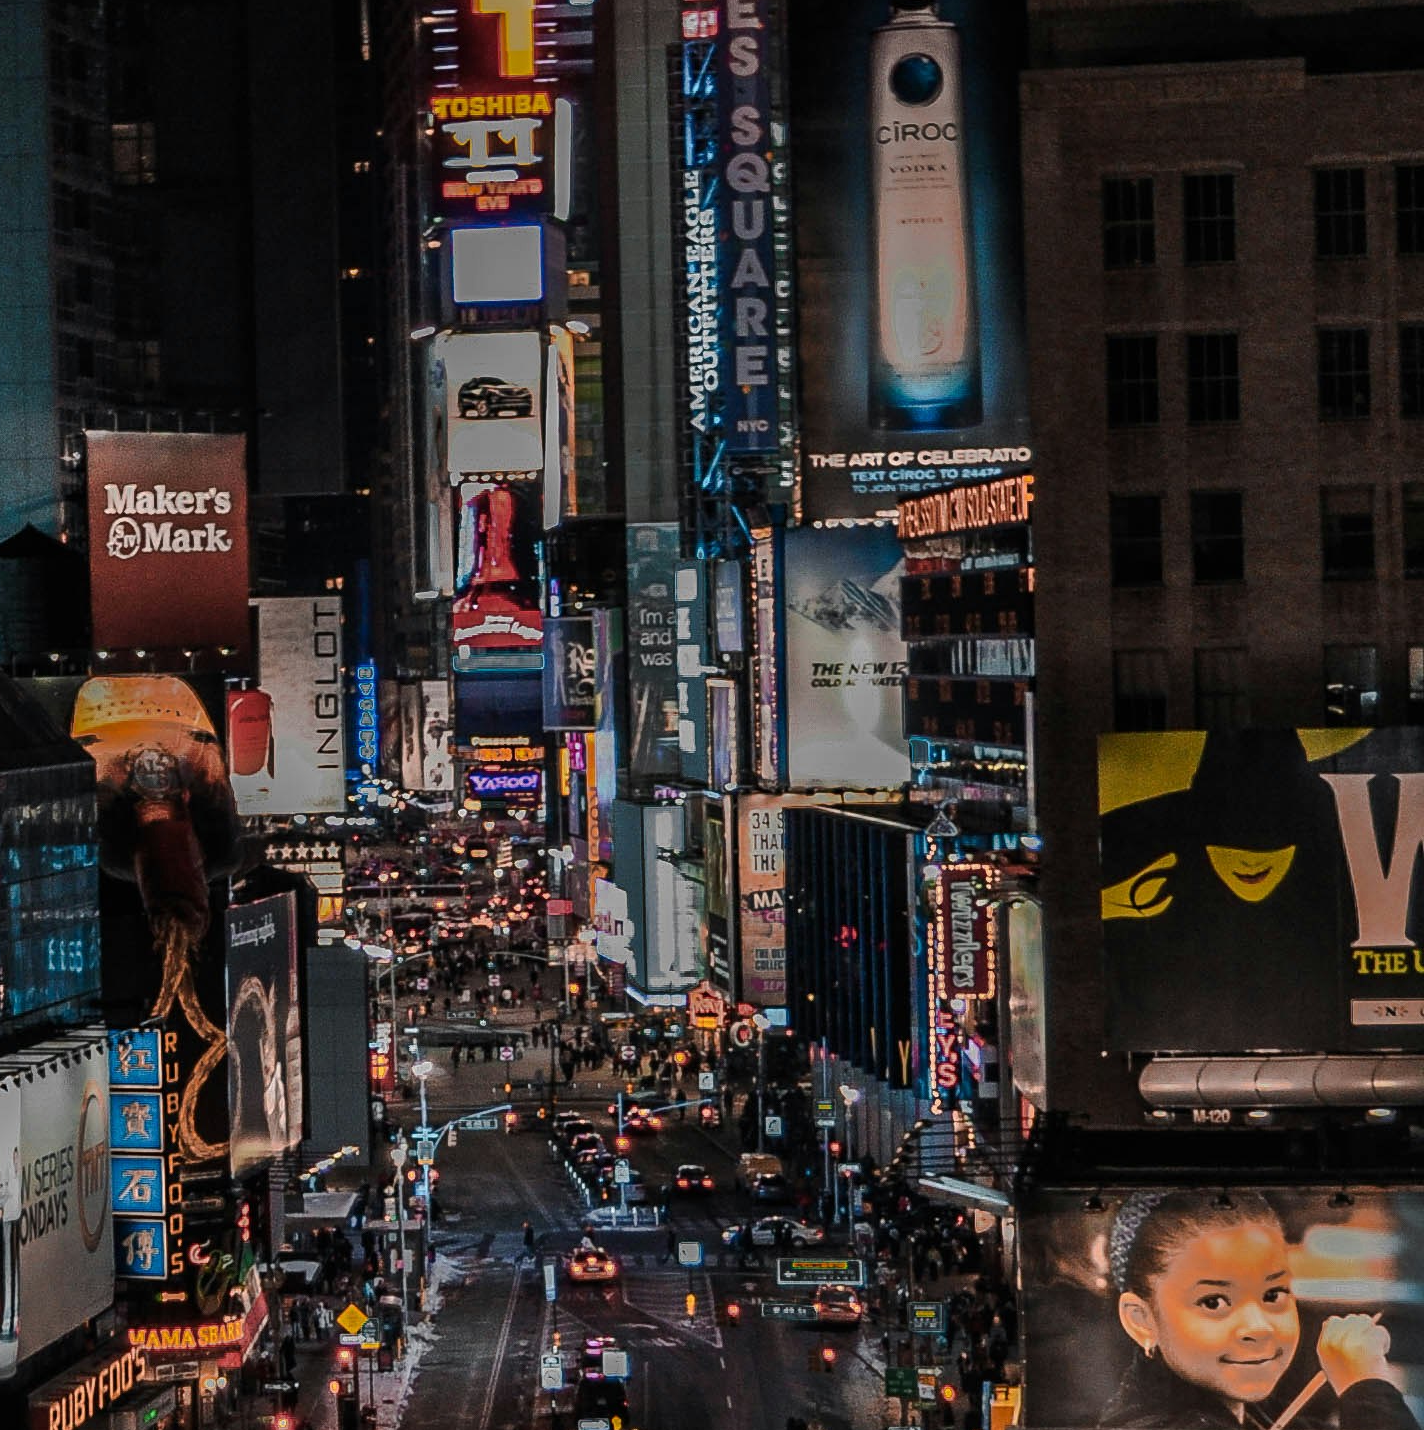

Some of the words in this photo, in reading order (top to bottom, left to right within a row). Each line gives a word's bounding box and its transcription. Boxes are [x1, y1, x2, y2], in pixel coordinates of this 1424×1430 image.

[431, 91, 552, 120] TOSHIBA
[726, 104, 772, 387] SQUARE
[698, 206, 720, 393] OUTFITTERS
[687, 271, 707, 433] AMERICAN
[736, 420, 770, 433] NYC
[808, 453, 846, 468] THE
[848, 451, 885, 467] ART
[888, 450, 915, 466] OF
[851, 470, 886, 482] TEXT
[939, 468, 959, 480] TO
[103, 483, 233, 515] Maker's
[141, 521, 233, 553] Mark
[639, 630, 672, 646] and
[639, 652, 673, 667] was
[811, 662, 844, 676] THE
[848, 661, 887, 675] NEW
[314, 601, 339, 770] INGLOT
[811, 677, 842, 688] COLD
[469, 774, 539, 791] YAHOO!
[751, 812, 770, 830] 34
[752, 854, 777, 872] THE
[950, 880, 982, 989] Twizzlers
[1351, 949, 1410, 975] THE
[164, 1031, 181, 1144] RUBY
[1192, 1108, 1231, 1124] M-120
[34, 1144, 74, 1195] SERIES
[17, 1189, 69, 1248] ONDAYS
[168, 1155, 185, 1276] FOO'S
[127, 1325, 197, 1350] MAMA
[97, 1346, 147, 1411] FOO'S
